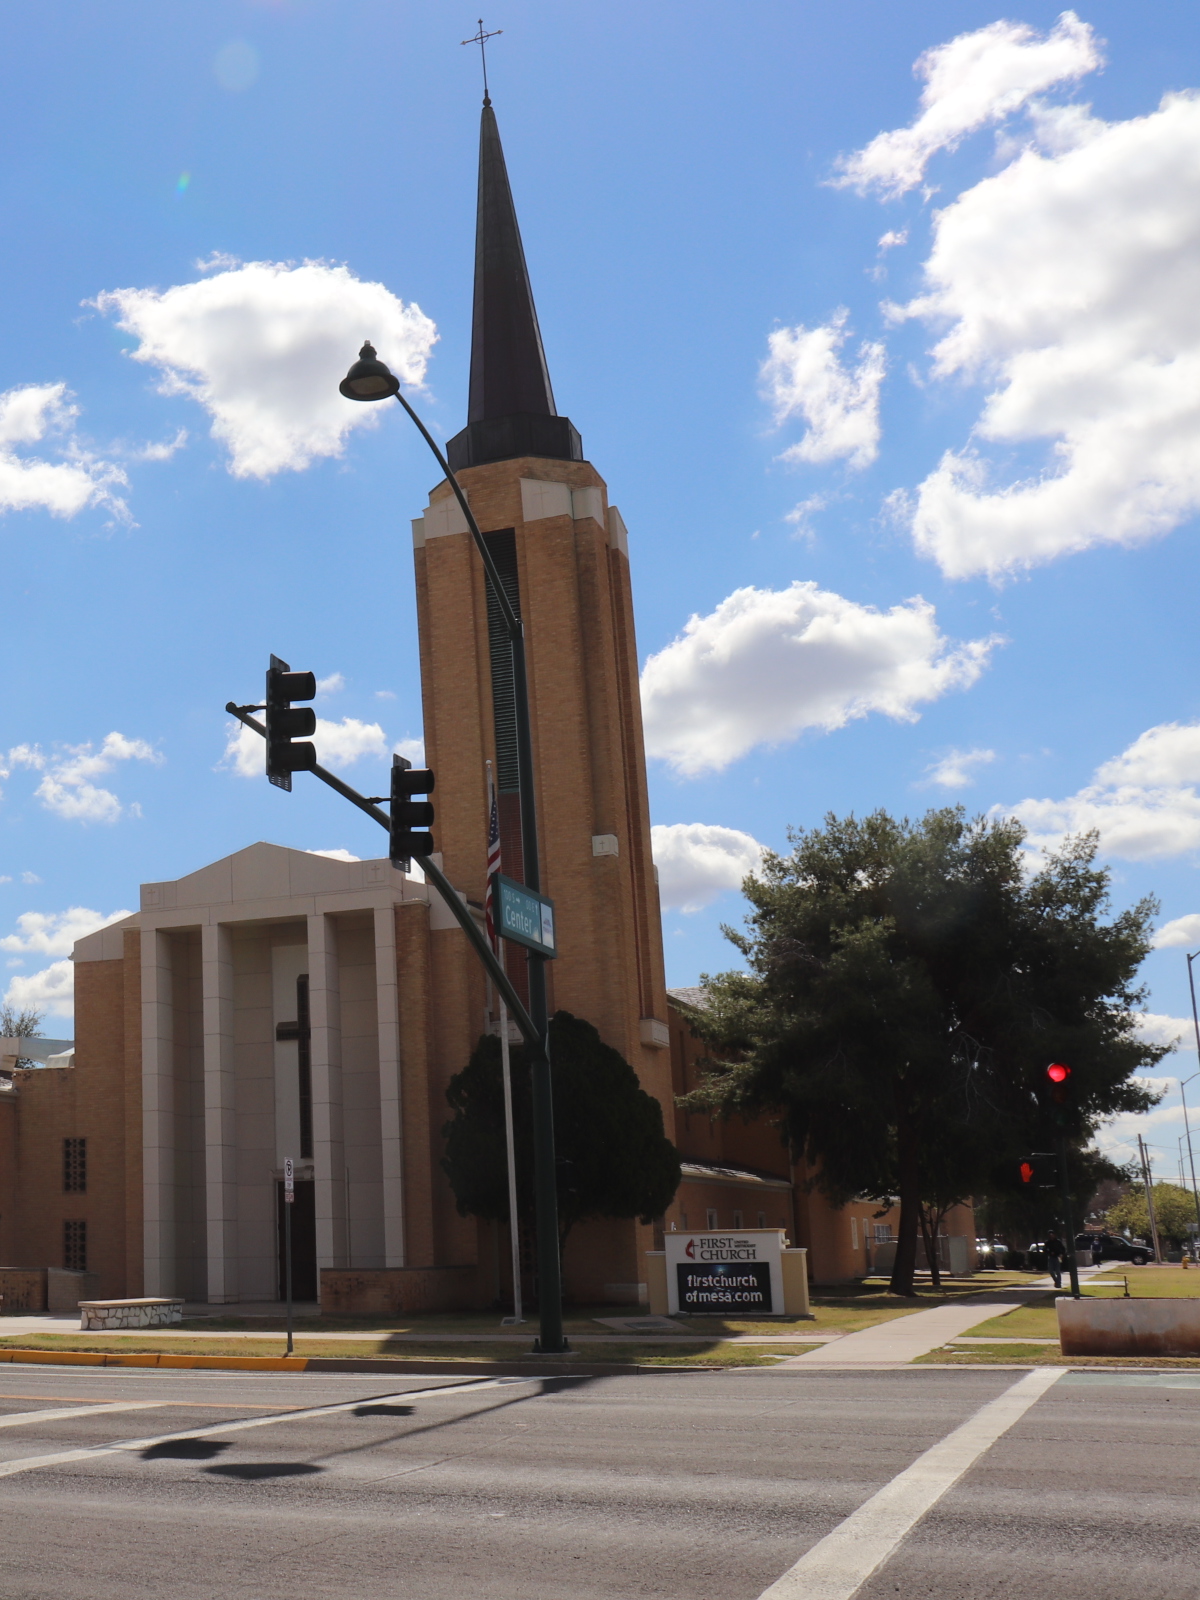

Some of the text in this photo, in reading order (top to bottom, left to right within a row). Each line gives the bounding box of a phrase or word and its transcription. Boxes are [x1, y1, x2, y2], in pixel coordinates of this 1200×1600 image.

[505, 905, 532, 935] Center
[700, 1239, 733, 1249] FIRST
[700, 1249, 757, 1260] CHURCH
[687, 1274, 758, 1287] firstchurch
[686, 1290, 763, 1303] ofmesa.com
